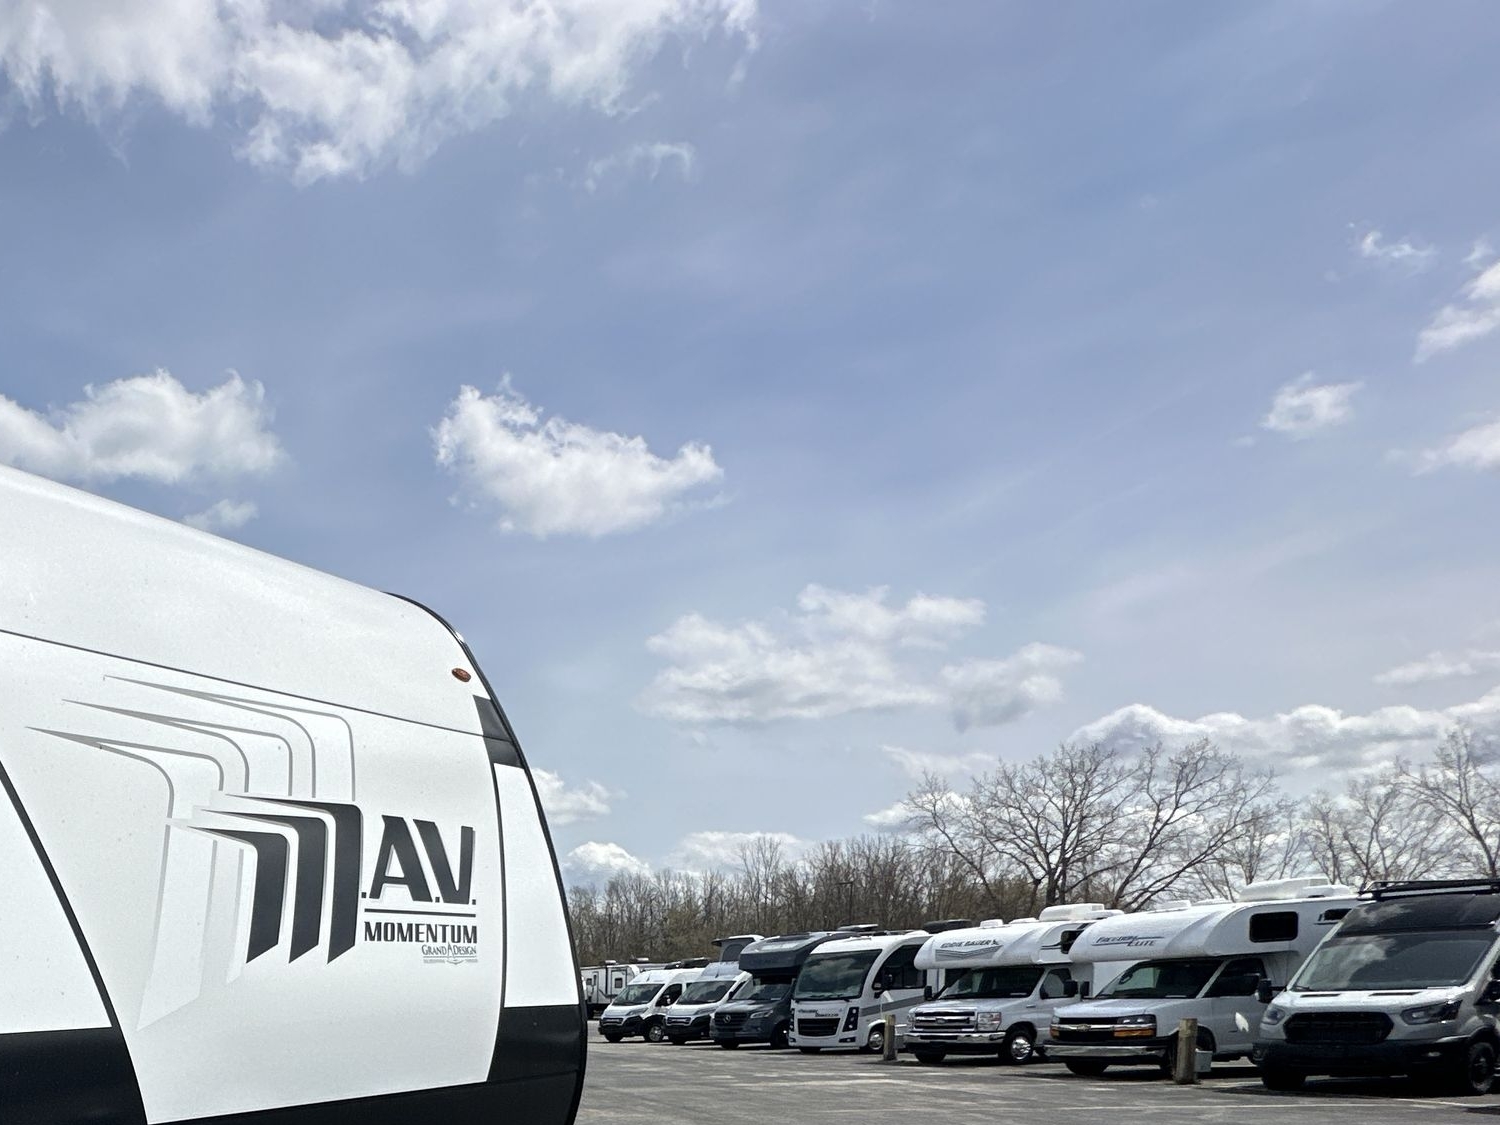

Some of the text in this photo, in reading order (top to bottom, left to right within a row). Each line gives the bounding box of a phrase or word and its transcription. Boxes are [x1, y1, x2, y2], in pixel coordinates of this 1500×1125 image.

[363, 921, 477, 943] MOMENTUM
[421, 944, 477, 956] GRAND DESIGN
